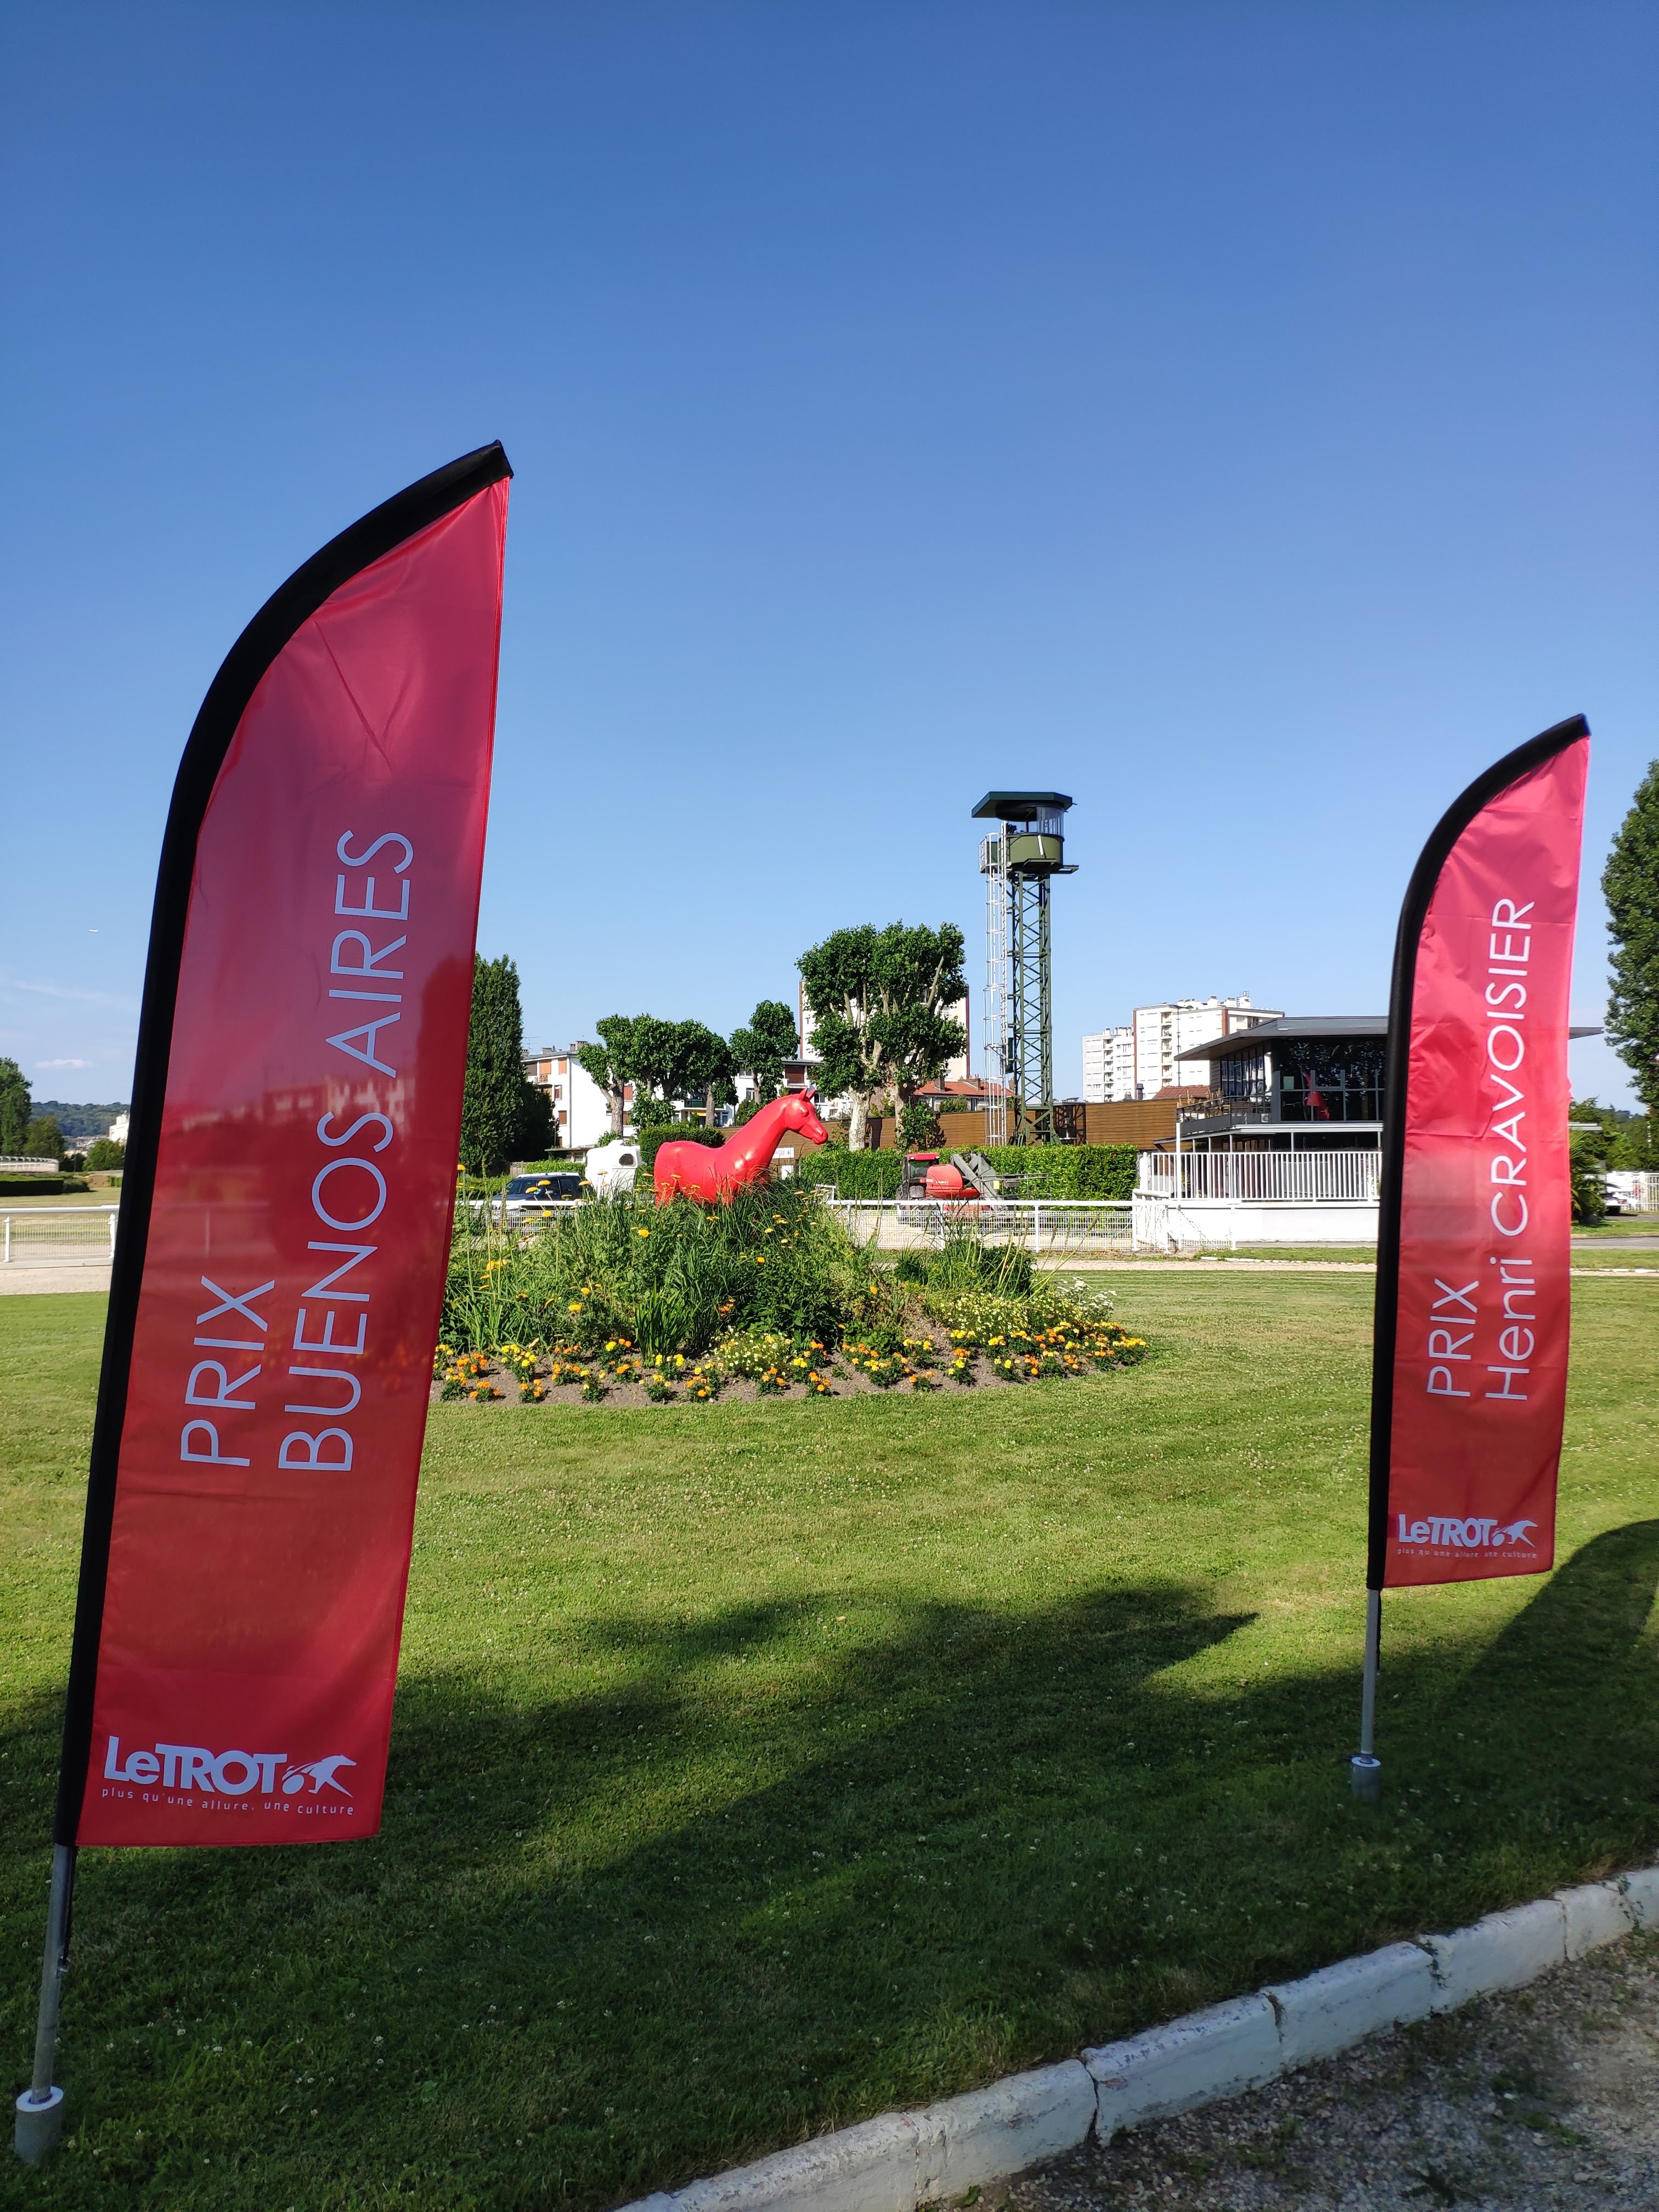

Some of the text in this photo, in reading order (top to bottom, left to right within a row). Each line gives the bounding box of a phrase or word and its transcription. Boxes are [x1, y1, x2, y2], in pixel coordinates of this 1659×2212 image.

[278, 829, 414, 1471] BUENOS AIRES
[1485, 898, 1536, 1401] Henri CRAVOISIER
[180, 1275, 275, 1467] PRIX
[1426, 1277, 1480, 1397] PRIX
[1397, 1547, 1415, 1555] plus
[1398, 1514, 1498, 1548] LeTROT
[101, 1787, 133, 1798] plus
[264, 1802, 290, 1812] une
[297, 1804, 354, 1815] culture
[104, 1735, 287, 1796] LeTROT
